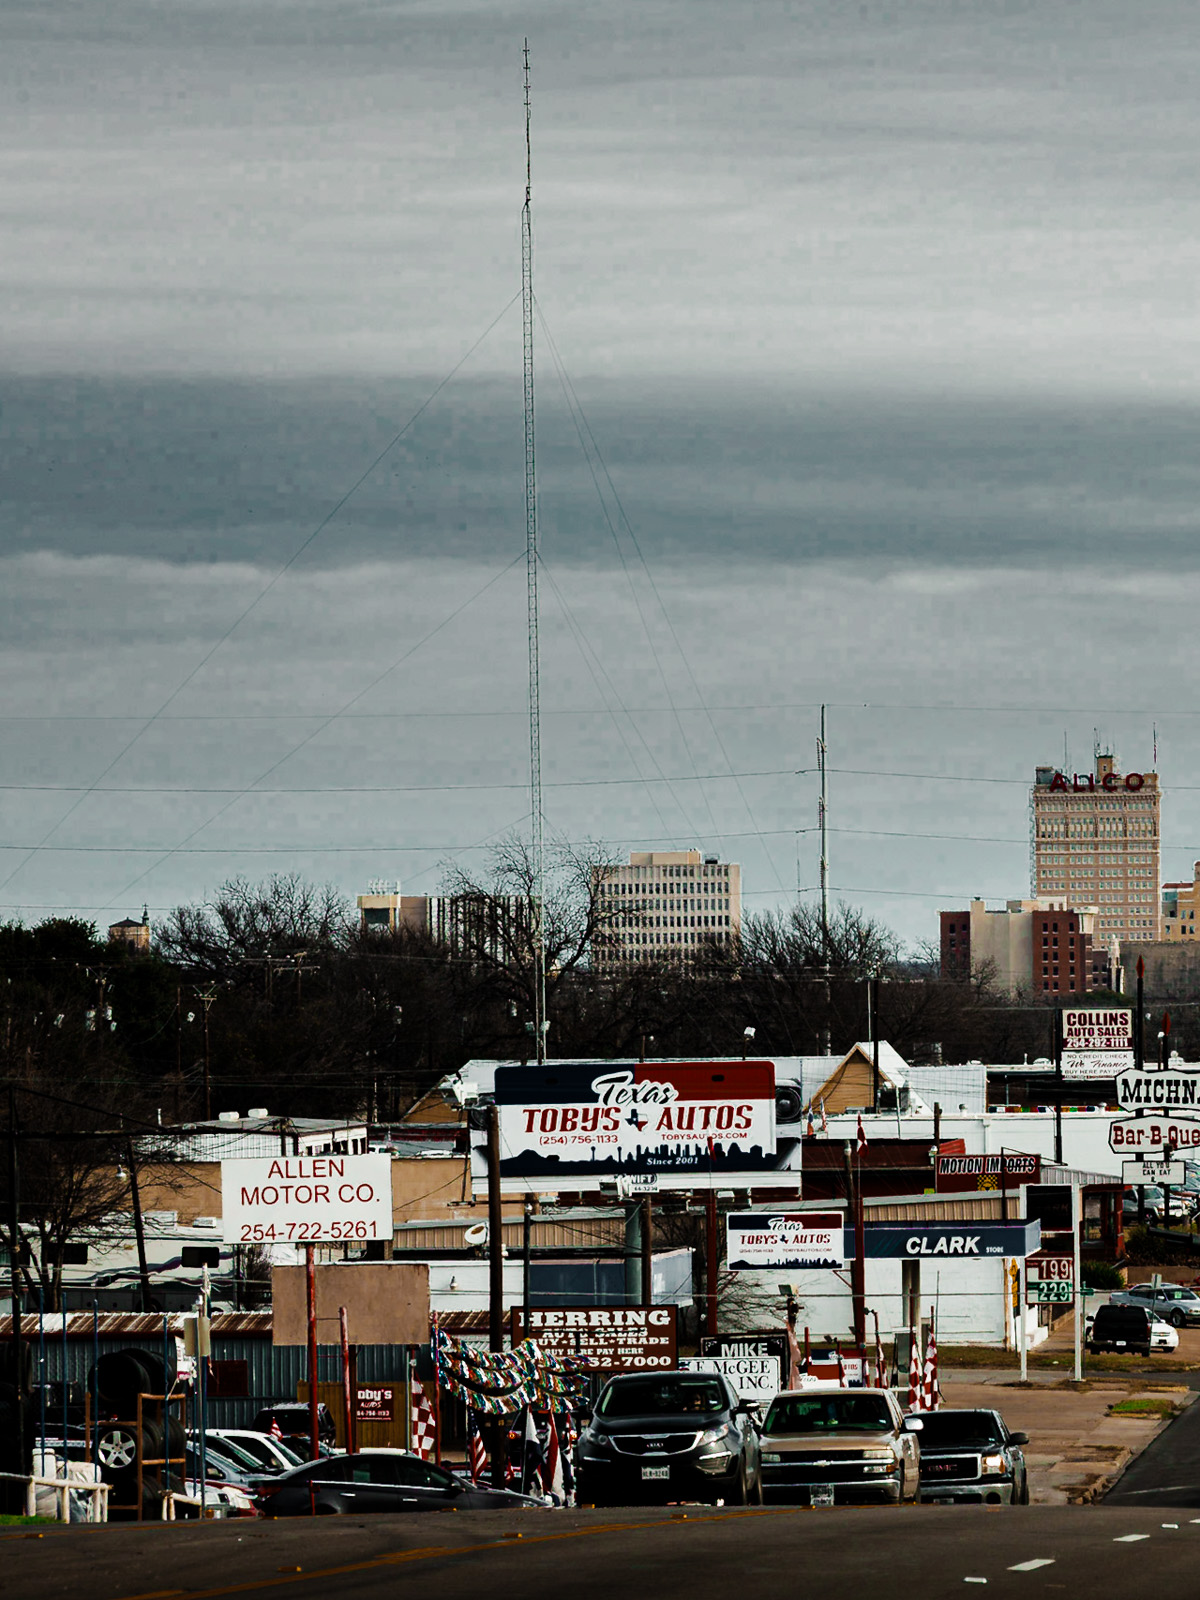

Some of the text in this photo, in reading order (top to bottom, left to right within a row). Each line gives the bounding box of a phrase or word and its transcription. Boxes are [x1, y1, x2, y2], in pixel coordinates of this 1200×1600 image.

[1049, 772, 1144, 792] ALICO
[1067, 1012, 1128, 1026] COLLINS
[1067, 1027, 1128, 1037] AUTO SALES
[1067, 1038, 1128, 1047] 254-292-1111
[1091, 1060, 1128, 1068] Finance
[593, 1072, 676, 1106] Texas
[523, 1105, 753, 1132] TOBY'S AUTOS
[539, 1136, 568, 1145] (254)
[571, 1135, 619, 1144] 756-1133
[1113, 1125, 1200, 1149] Bar-B-Que
[647, 1156, 699, 1166] Since 2001
[939, 1157, 983, 1174] MOTION
[268, 1159, 344, 1178] ALLEN
[241, 1183, 380, 1205] MOTOR CO.
[240, 1221, 377, 1242] 254-722-5261
[769, 1218, 801, 1231] Texas
[793, 1233, 831, 1244] AUTOS
[906, 1236, 981, 1254] CLARK
[1041, 1260, 1069, 1278] 199
[519, 1310, 671, 1327] HERRING
[615, 1337, 670, 1345] TRADE
[721, 1343, 769, 1357] MIKE
[713, 1360, 771, 1374] McGEE
[739, 1376, 773, 1389] INC.
